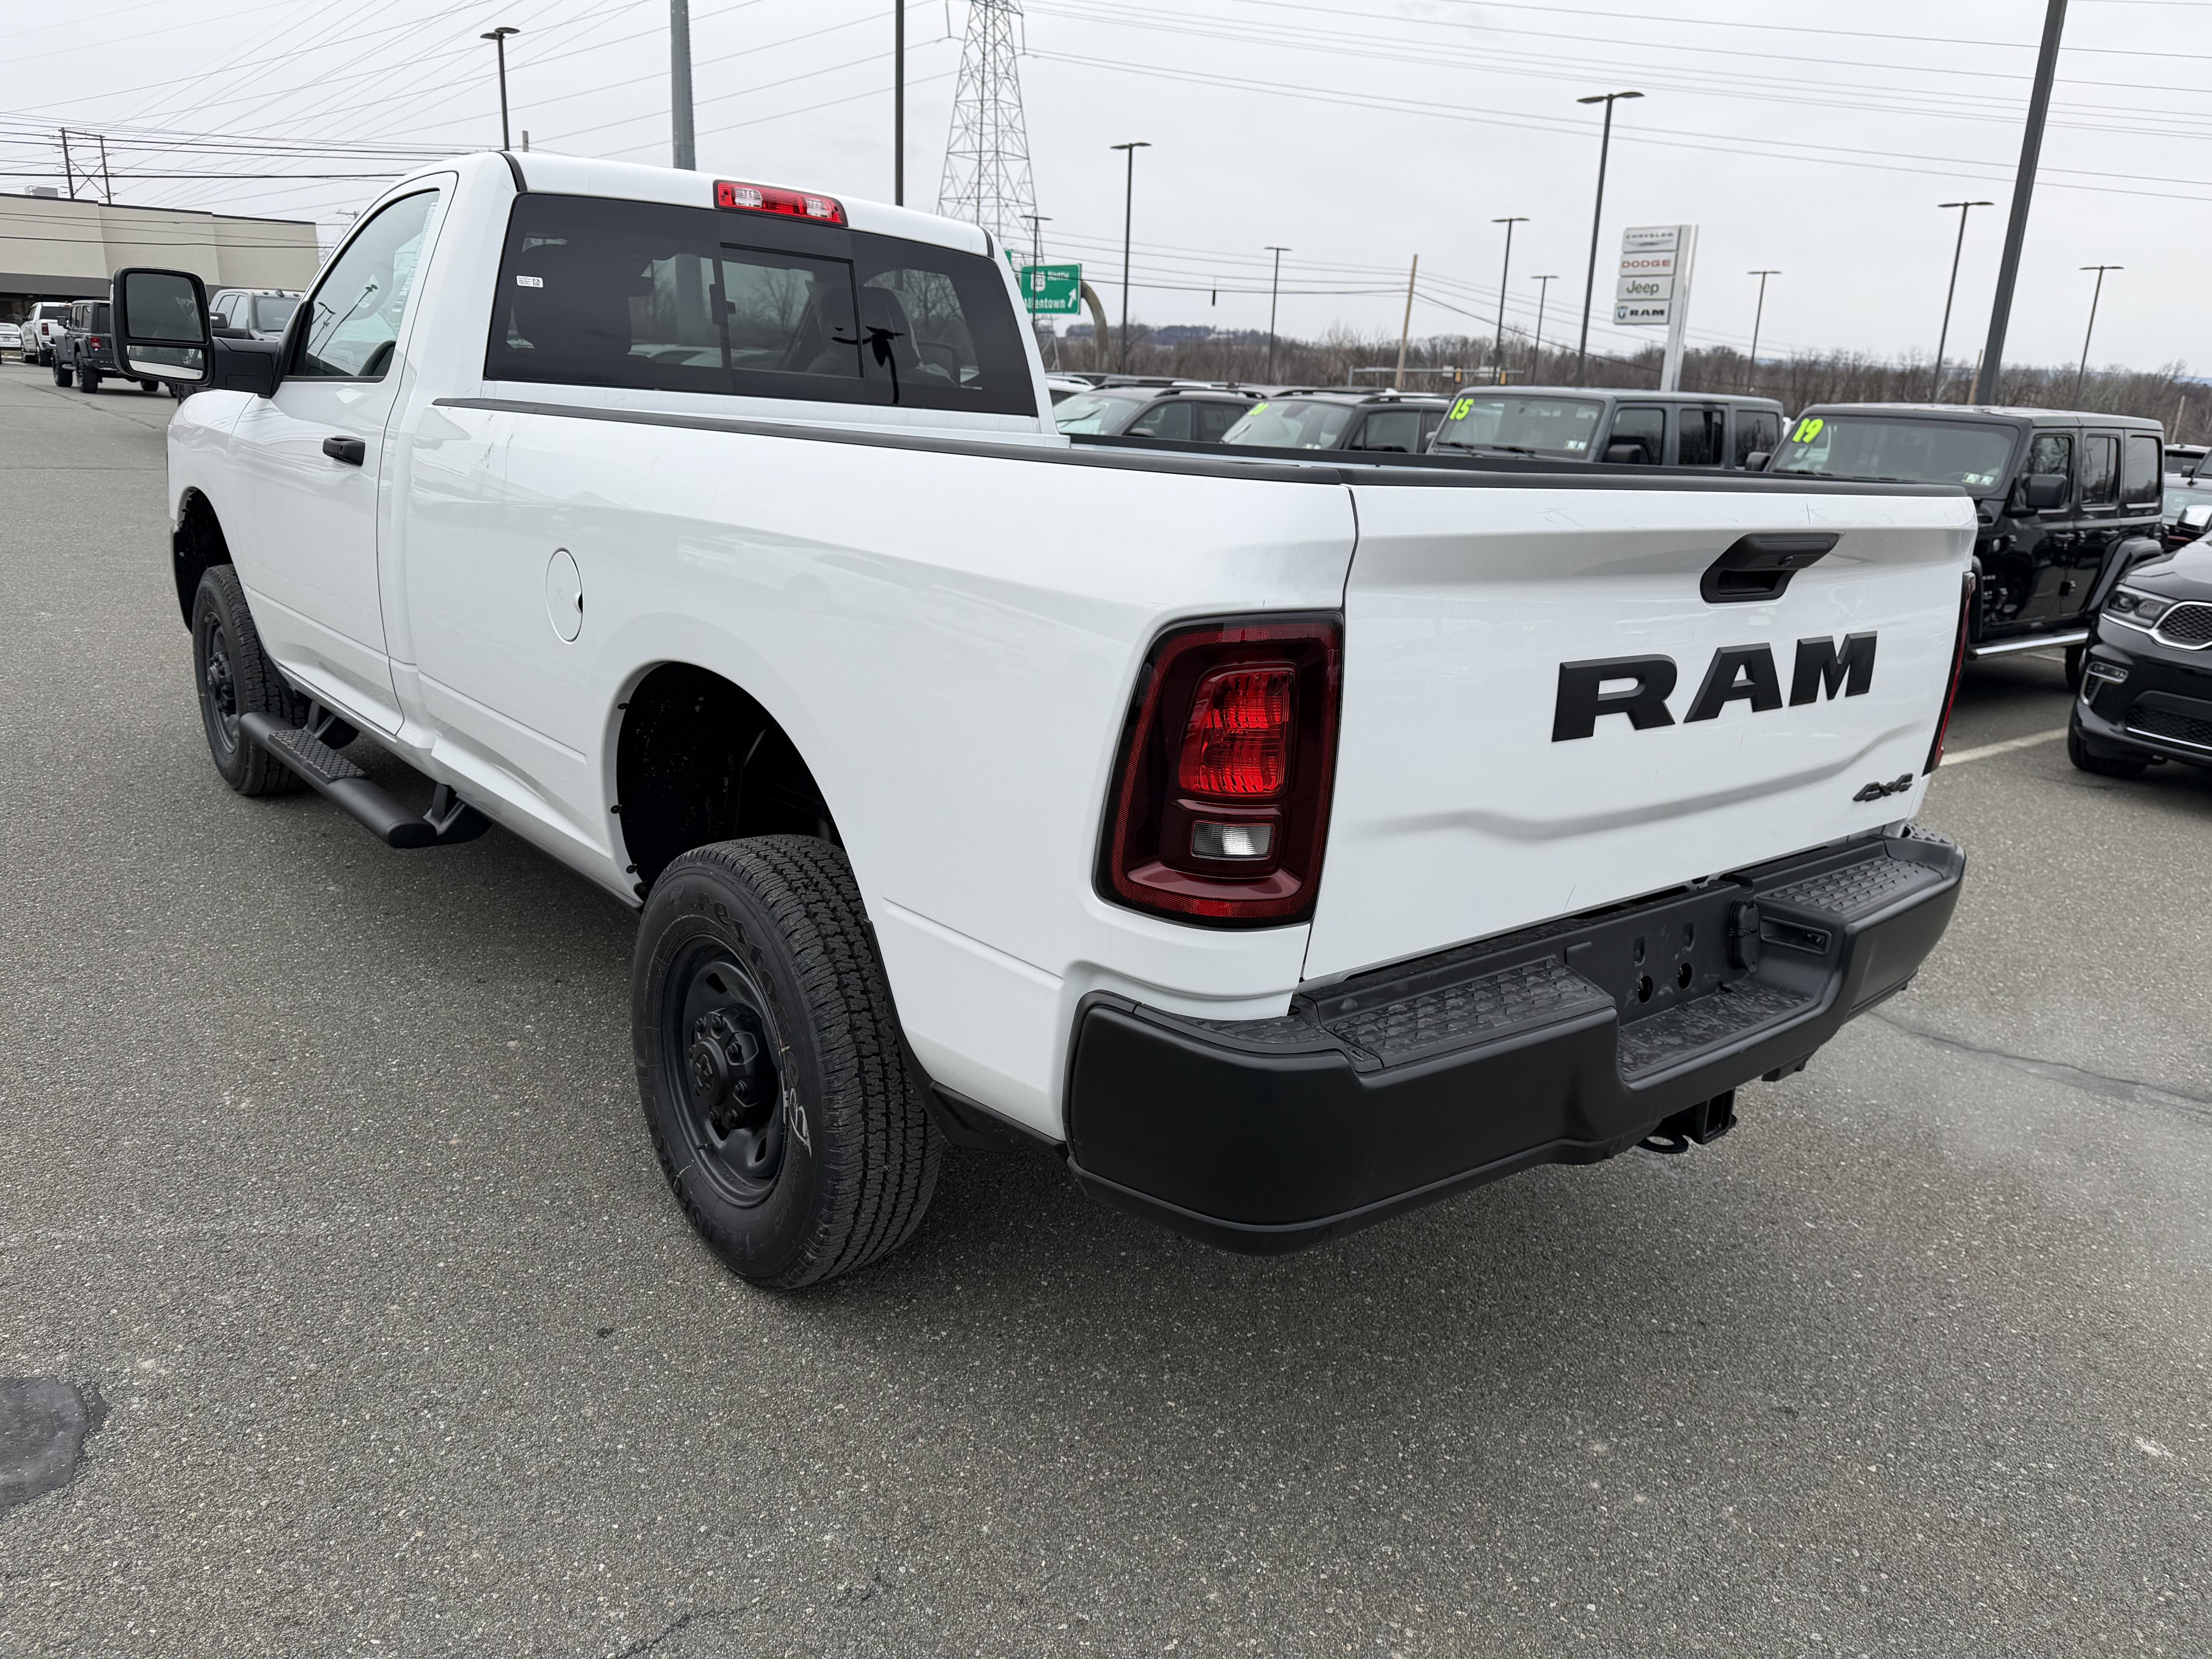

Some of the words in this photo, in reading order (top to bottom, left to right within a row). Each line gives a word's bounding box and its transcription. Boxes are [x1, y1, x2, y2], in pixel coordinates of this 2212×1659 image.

[1621, 259, 1671, 268] DODGE
[1626, 280, 1659, 296] Jeep
[1449, 397, 1475, 421] 15
[1792, 417, 1824, 444] 19
[1551, 630, 1877, 742] RAM
[669, 884, 800, 1089] Firestone
